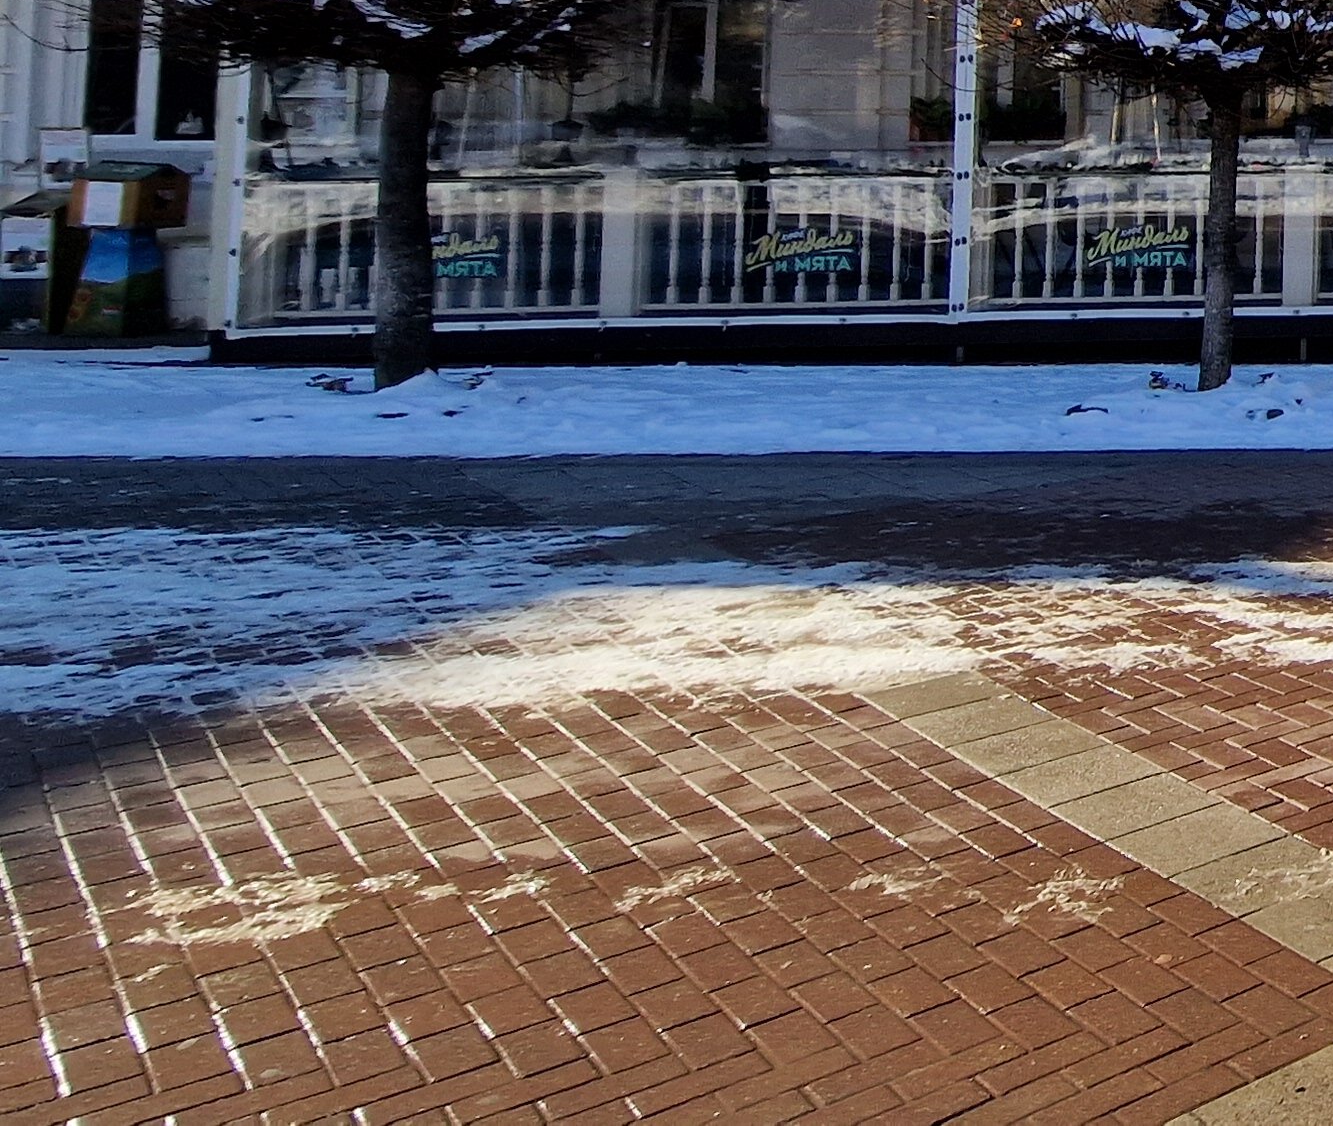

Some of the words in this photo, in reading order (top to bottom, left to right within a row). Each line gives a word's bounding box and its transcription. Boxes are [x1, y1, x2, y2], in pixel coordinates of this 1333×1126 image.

[431, 232, 500, 260] ндаль
[745, 228, 854, 265] Миндаль
[1086, 225, 1189, 260] Миндаль
[436, 260, 498, 277] МЯТА
[794, 256, 852, 272] МЯТА
[1133, 251, 1187, 267] МЯТА
